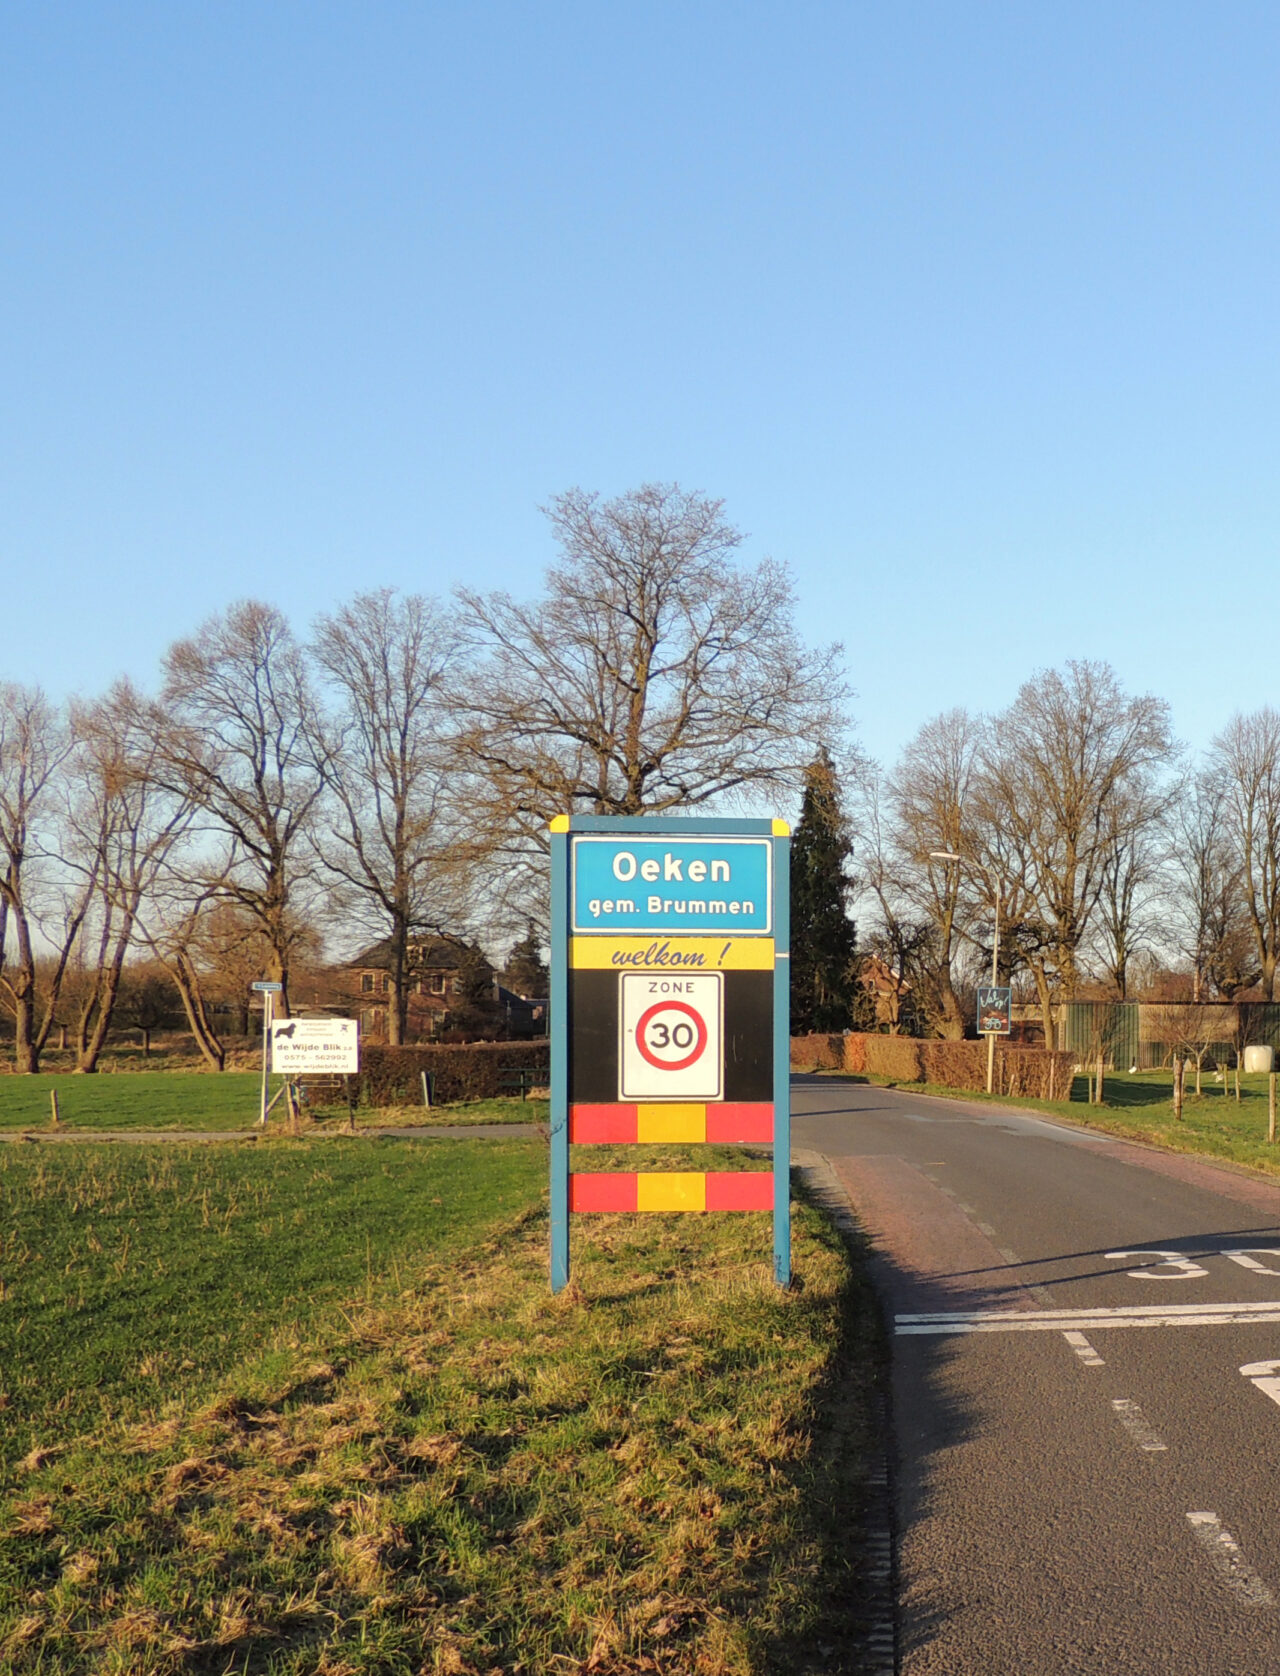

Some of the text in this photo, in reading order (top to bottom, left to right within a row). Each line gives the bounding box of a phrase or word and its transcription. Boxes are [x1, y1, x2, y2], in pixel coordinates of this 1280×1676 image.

[612, 851, 731, 882] Oeken
[588, 896, 755, 918] gem. Brummen
[611, 941, 707, 967] welkom
[648, 981, 695, 993] ZONE
[292, 1043, 320, 1052] Wijde
[323, 1043, 341, 1051] Blik
[649, 1022, 694, 1049] 30
